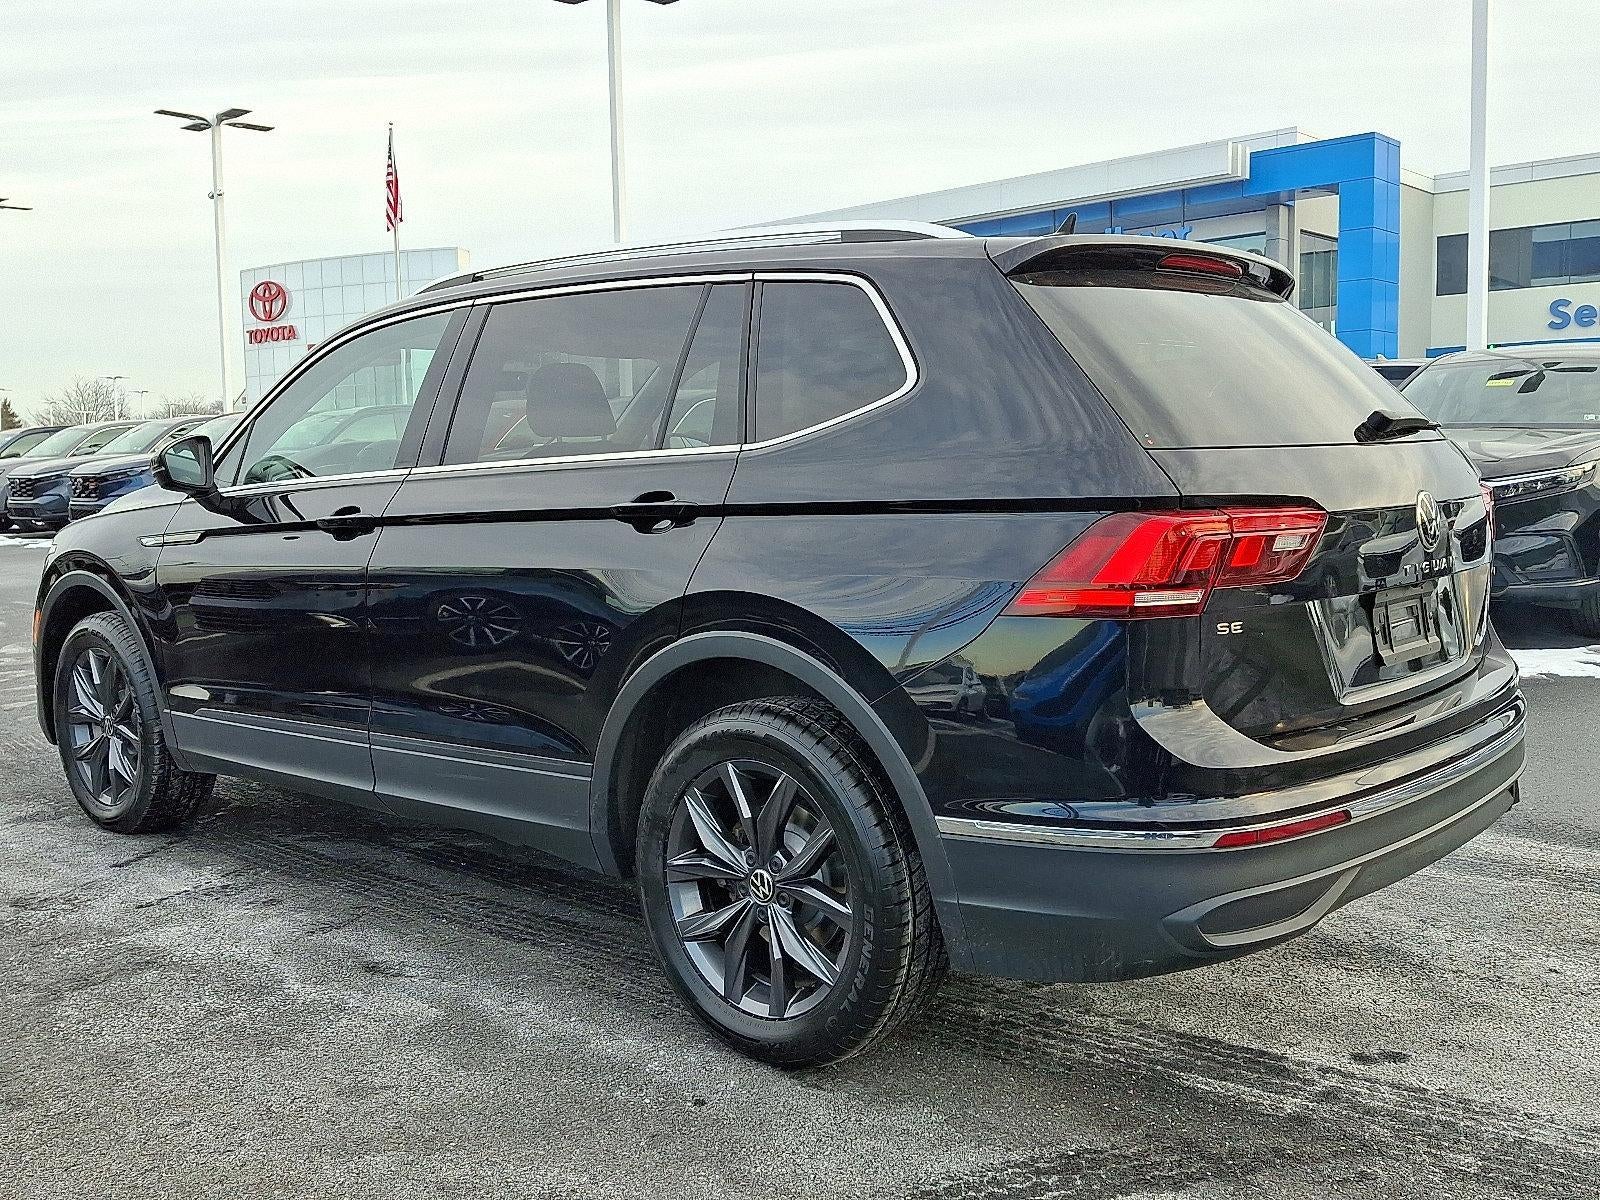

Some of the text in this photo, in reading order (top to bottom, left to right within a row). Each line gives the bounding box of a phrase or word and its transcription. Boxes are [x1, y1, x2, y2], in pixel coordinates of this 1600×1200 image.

[246, 325, 297, 345] TOYOTA
[1216, 621, 1244, 635] SE
[839, 903, 875, 1013] GENERAL
